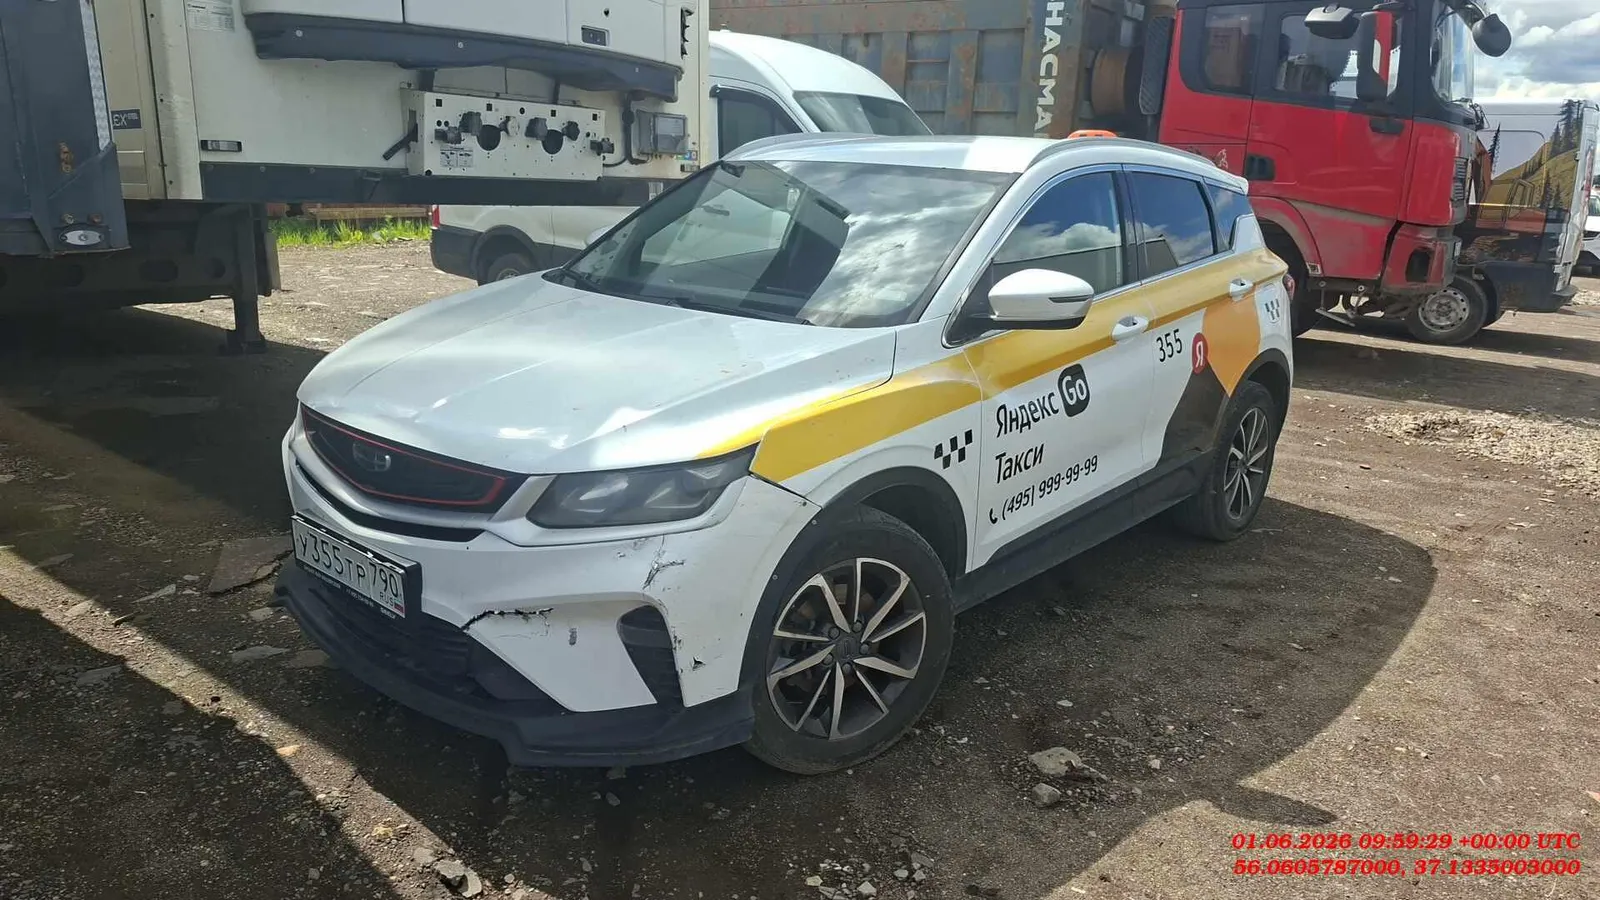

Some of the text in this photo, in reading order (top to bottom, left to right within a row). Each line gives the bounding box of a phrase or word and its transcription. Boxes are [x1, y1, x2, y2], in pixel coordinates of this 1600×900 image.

[1034, 0, 1065, 138] HACMA
[1156, 328, 1183, 363] 355
[1195, 340, 1204, 368] Я
[996, 375, 1087, 438] Яндекс Go
[995, 443, 1045, 484] Такси
[1002, 455, 1098, 520] (495) 999-99-99
[379, 591, 394, 608] RUS
